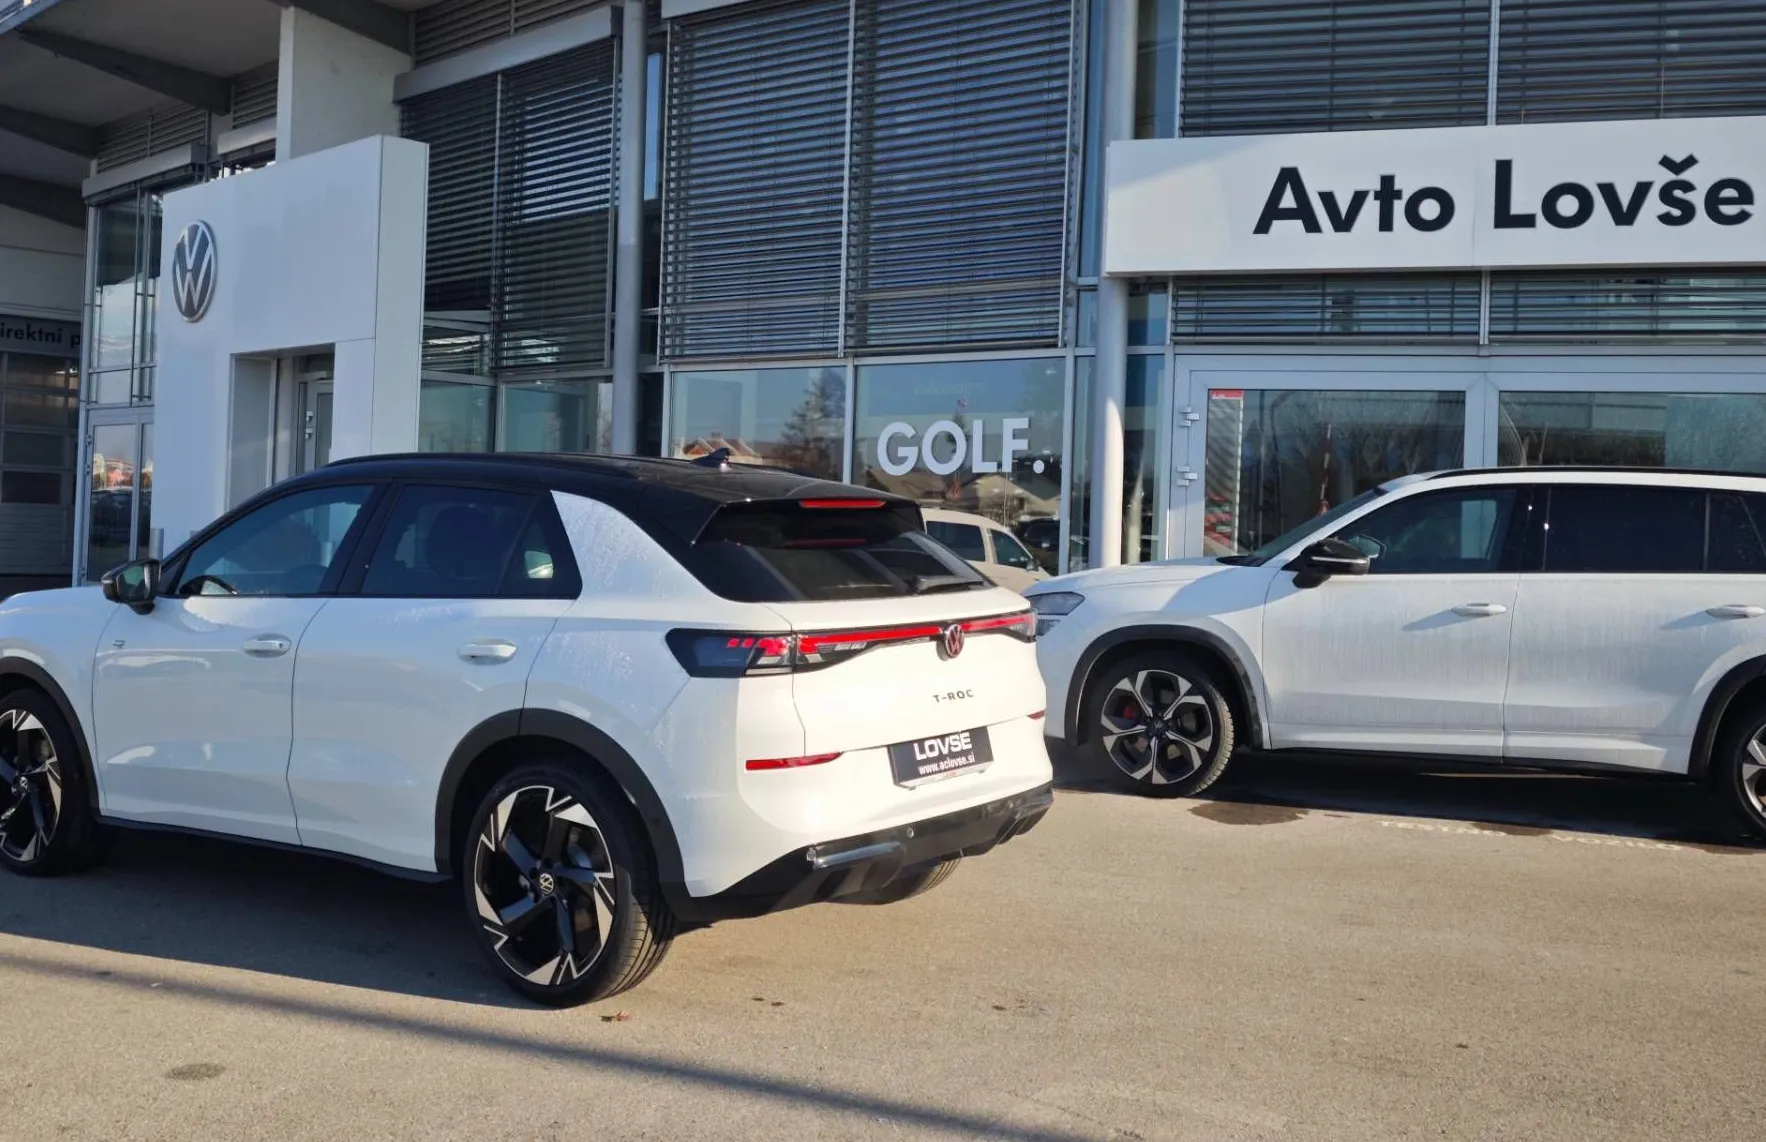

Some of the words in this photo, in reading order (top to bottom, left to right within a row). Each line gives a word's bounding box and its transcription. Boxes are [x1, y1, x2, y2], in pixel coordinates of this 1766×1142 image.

[1252, 166, 1456, 235] Avto
[1493, 153, 1755, 230] Lovše
[877, 417, 1045, 476] GOLF.
[932, 689, 974, 703] T-ROC
[917, 751, 976, 775] www.aclovse.si
